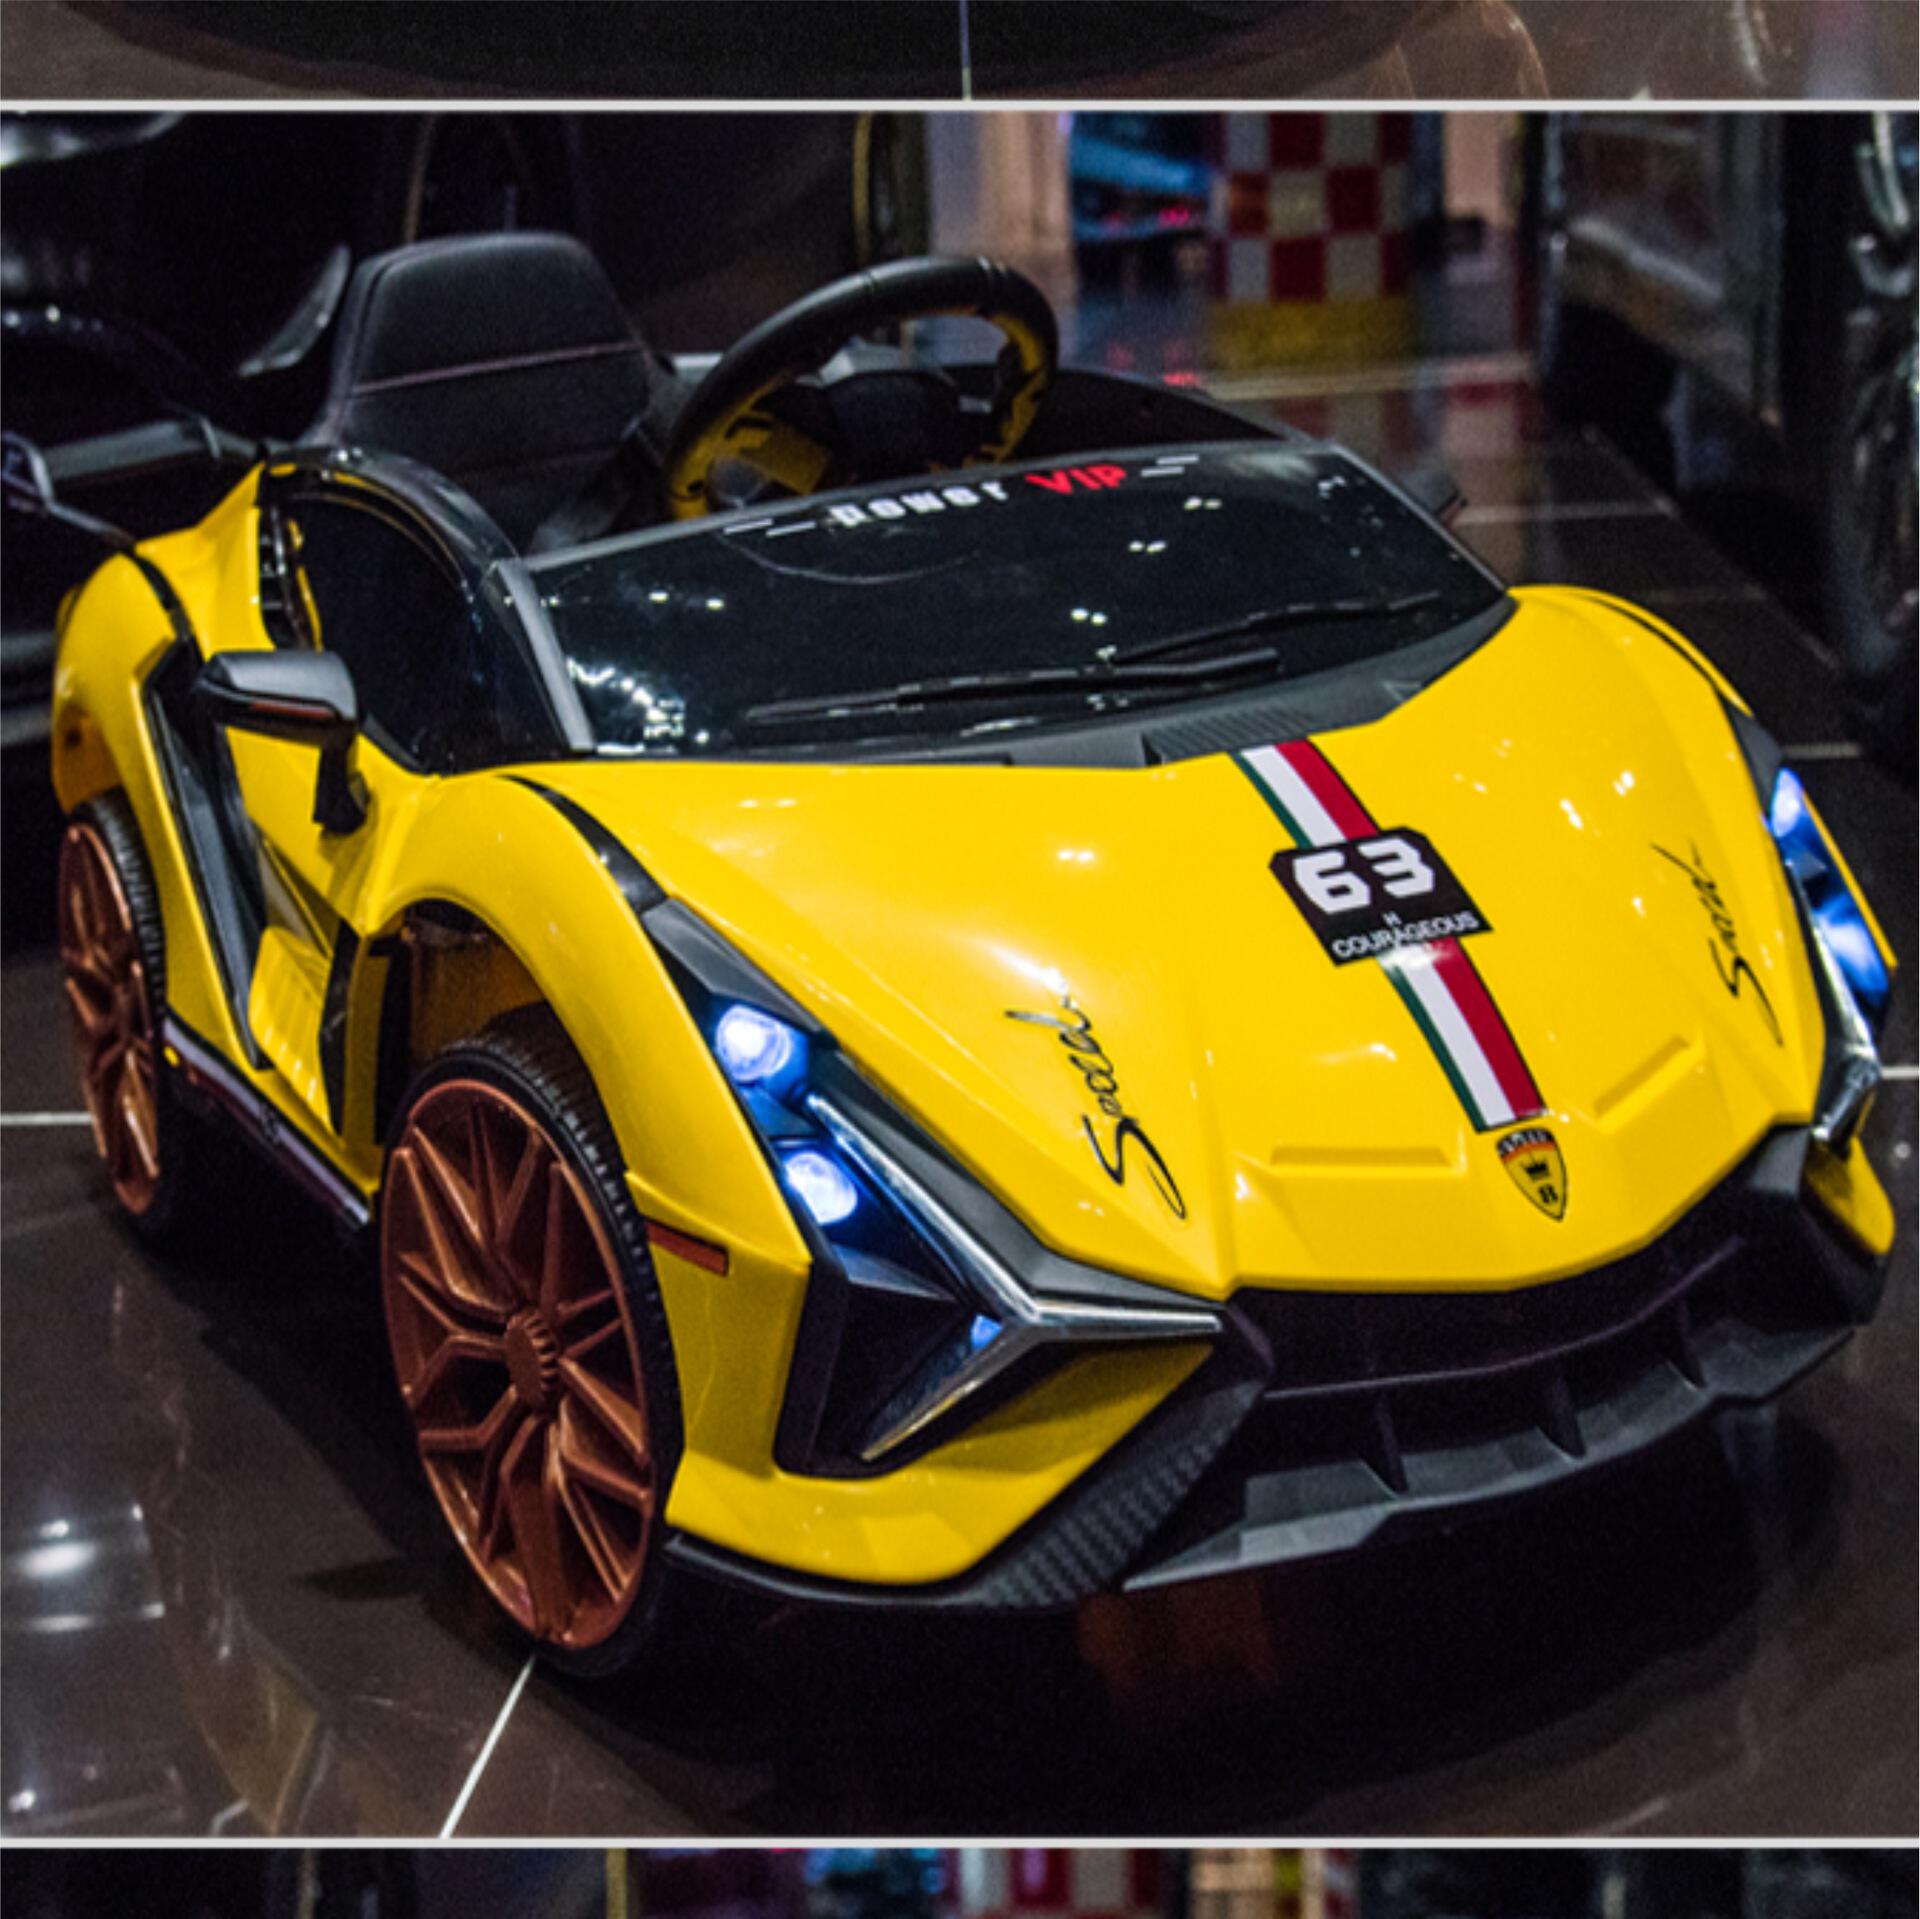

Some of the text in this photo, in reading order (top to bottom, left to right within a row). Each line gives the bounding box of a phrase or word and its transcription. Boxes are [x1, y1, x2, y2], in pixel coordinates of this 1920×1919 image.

[1025, 464, 1127, 494] VIP
[1292, 836, 1436, 915] 63
[1332, 910, 1480, 957] COURAGEOUS
